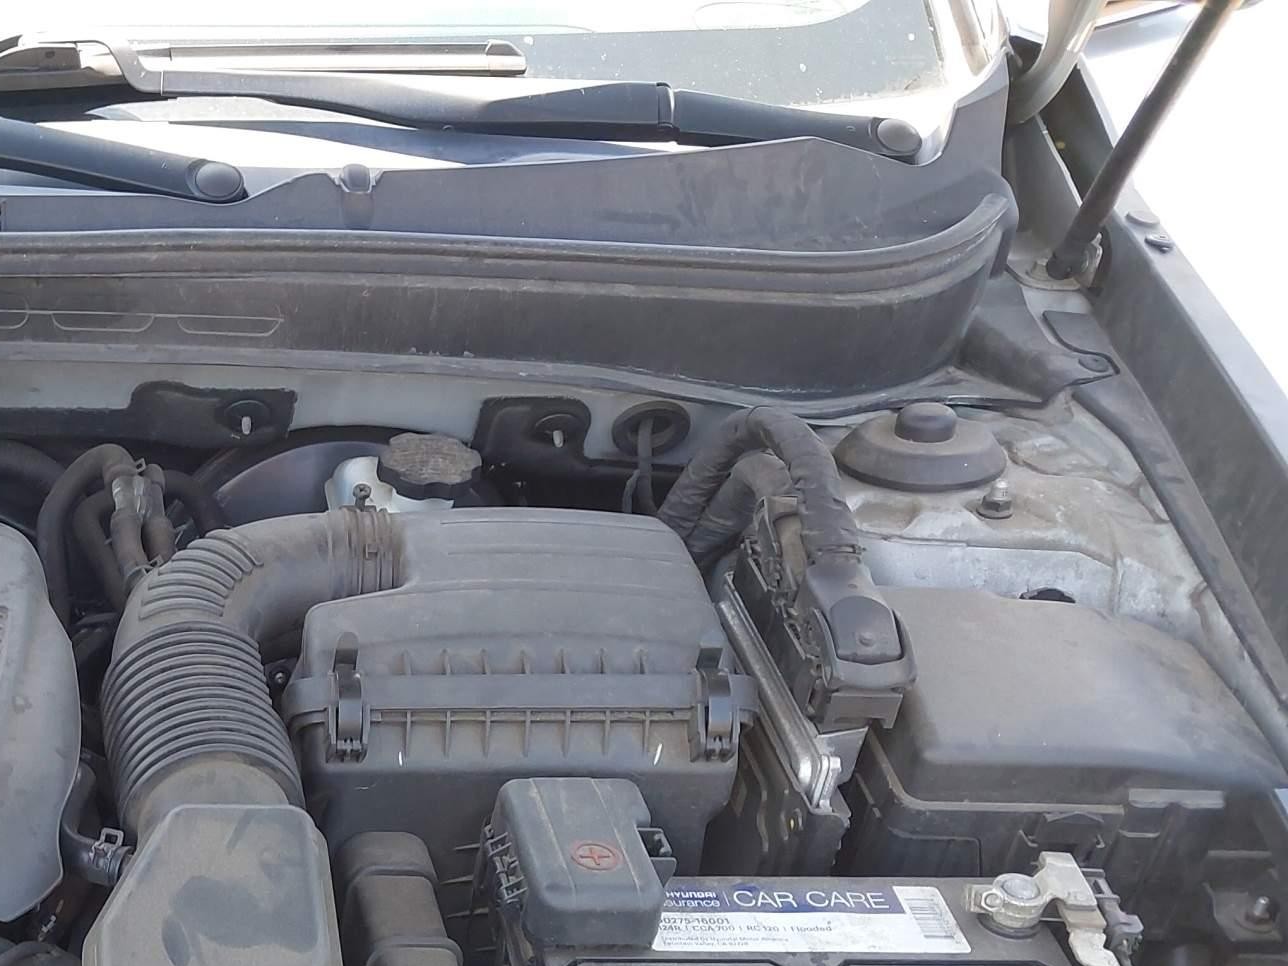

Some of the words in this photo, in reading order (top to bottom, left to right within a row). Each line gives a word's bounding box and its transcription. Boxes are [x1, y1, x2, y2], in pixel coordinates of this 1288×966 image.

[665, 890, 716, 899] HYUNDAI
[733, 890, 798, 909] CAR
[806, 890, 890, 909] CARE
[660, 916, 730, 925] 0275-16001
